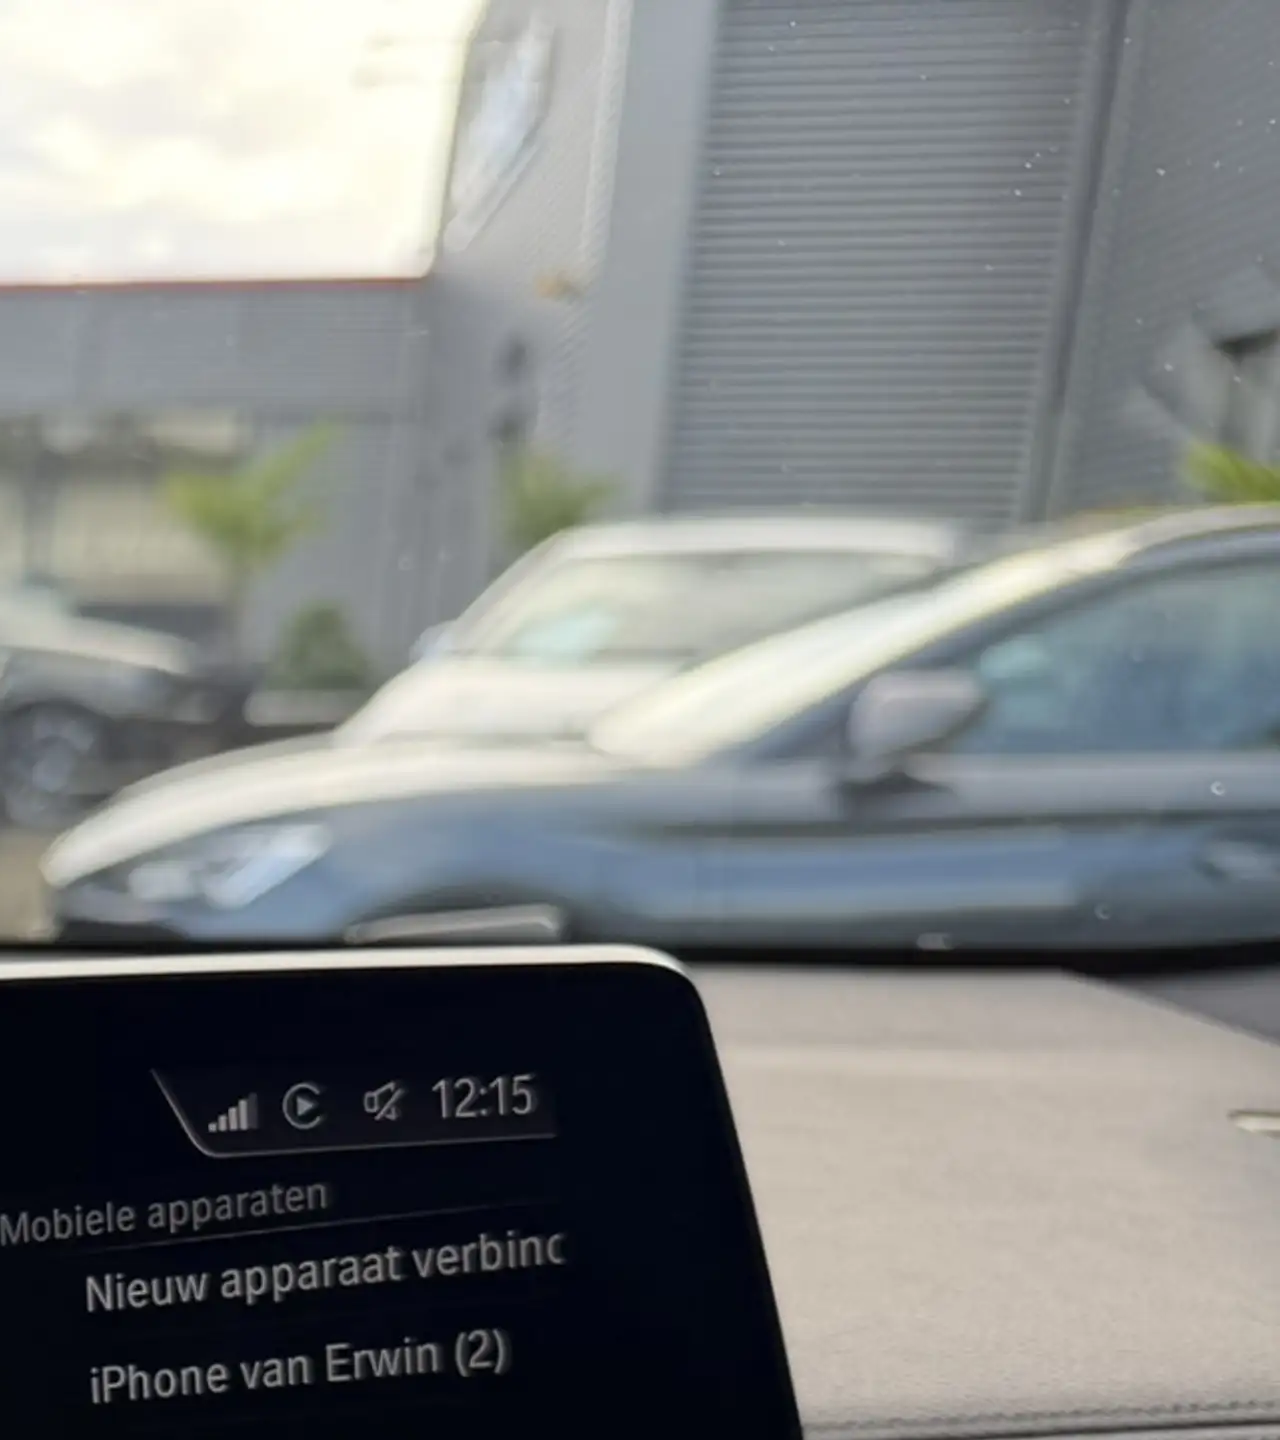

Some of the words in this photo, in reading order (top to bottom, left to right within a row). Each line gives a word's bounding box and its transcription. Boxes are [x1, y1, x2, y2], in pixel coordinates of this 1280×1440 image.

[431, 1073, 532, 1119] 12:15
[146, 1182, 328, 1233] apparaten
[85, 1272, 208, 1312] Nieuw
[219, 1245, 402, 1302] apparaat
[90, 1362, 228, 1404] iPhone
[238, 1354, 310, 1389] van
[324, 1336, 439, 1382] Erwin
[454, 1328, 505, 1377] (2)
